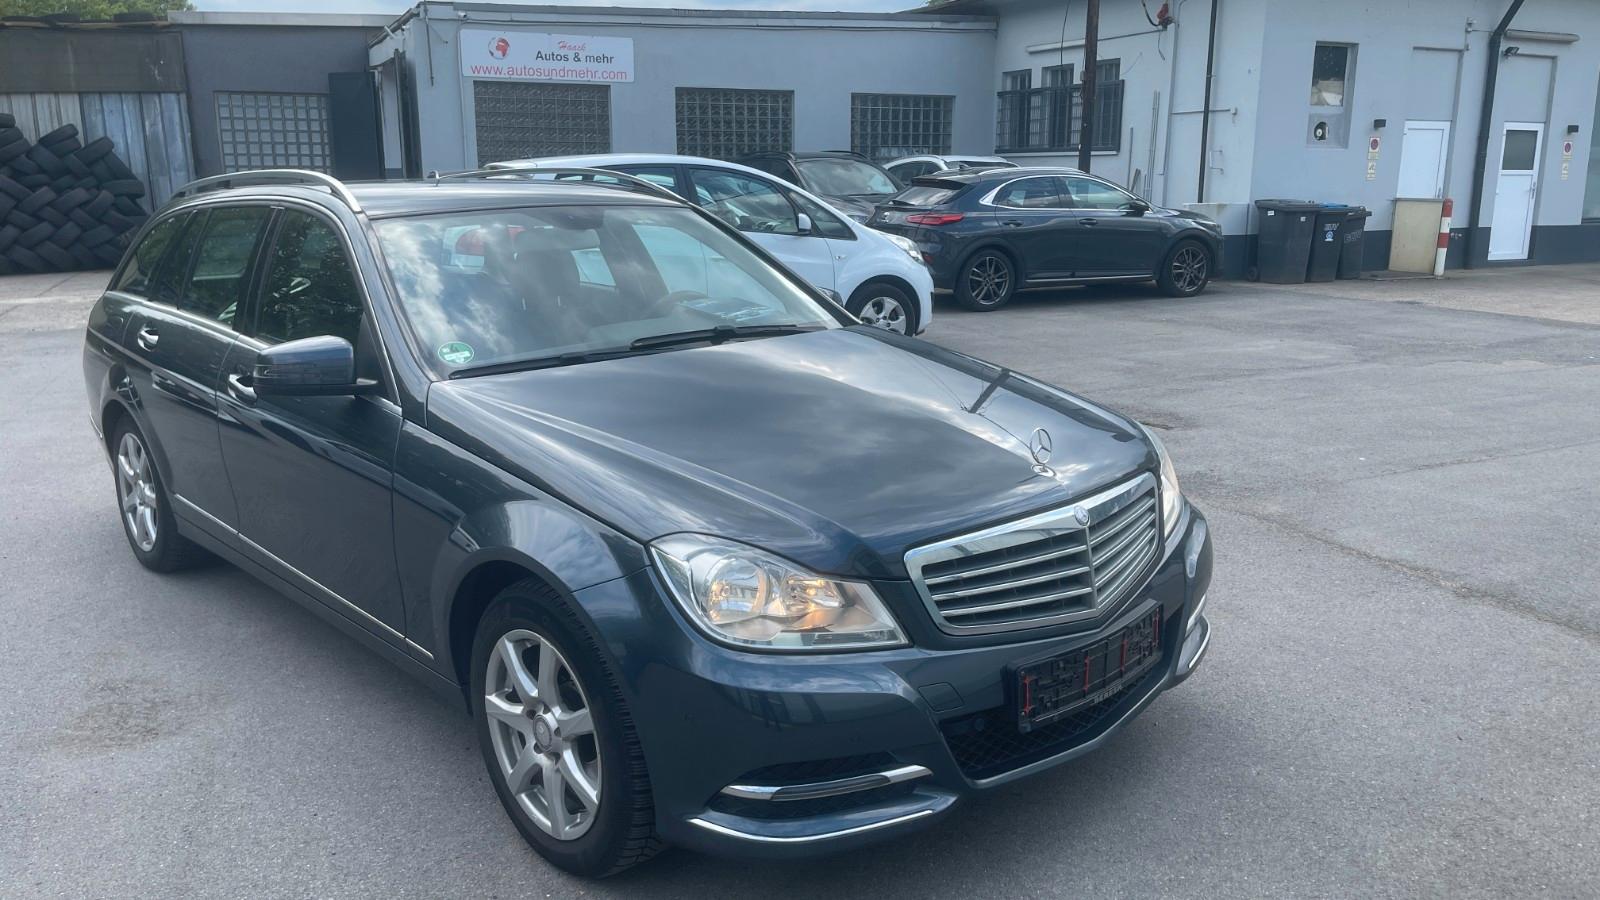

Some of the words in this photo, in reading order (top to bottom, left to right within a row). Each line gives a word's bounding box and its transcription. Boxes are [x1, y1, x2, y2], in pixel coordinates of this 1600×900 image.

[535, 50, 569, 62] Autos
[573, 52, 582, 63] &
[585, 54, 614, 64] mehr
[470, 64, 627, 80] www.autosundmehr.com
